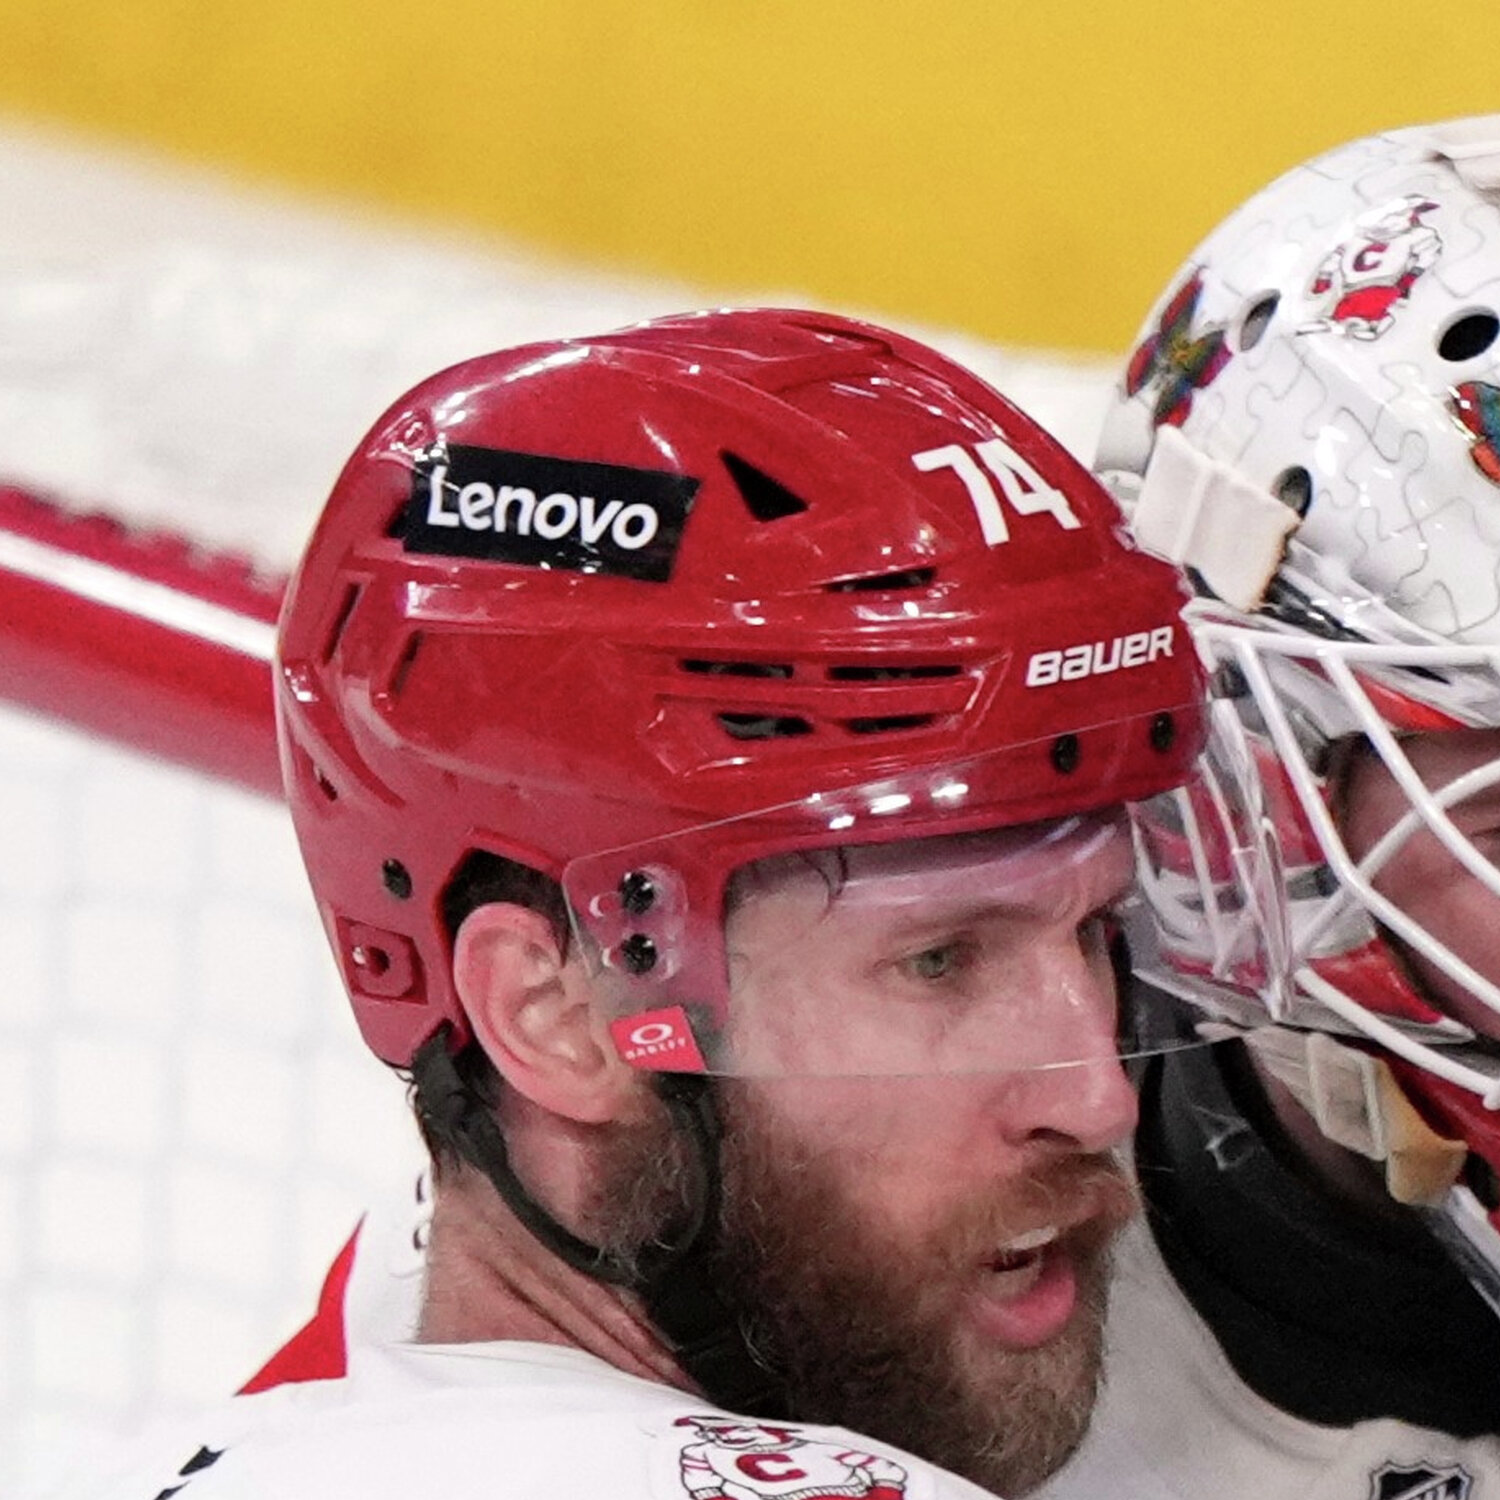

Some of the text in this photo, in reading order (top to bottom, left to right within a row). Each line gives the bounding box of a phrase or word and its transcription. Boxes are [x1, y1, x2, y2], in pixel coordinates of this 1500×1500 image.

[427, 464, 658, 549] Lenovo
[911, 438, 1081, 547] 74
[1025, 625, 1174, 687] BAUER
